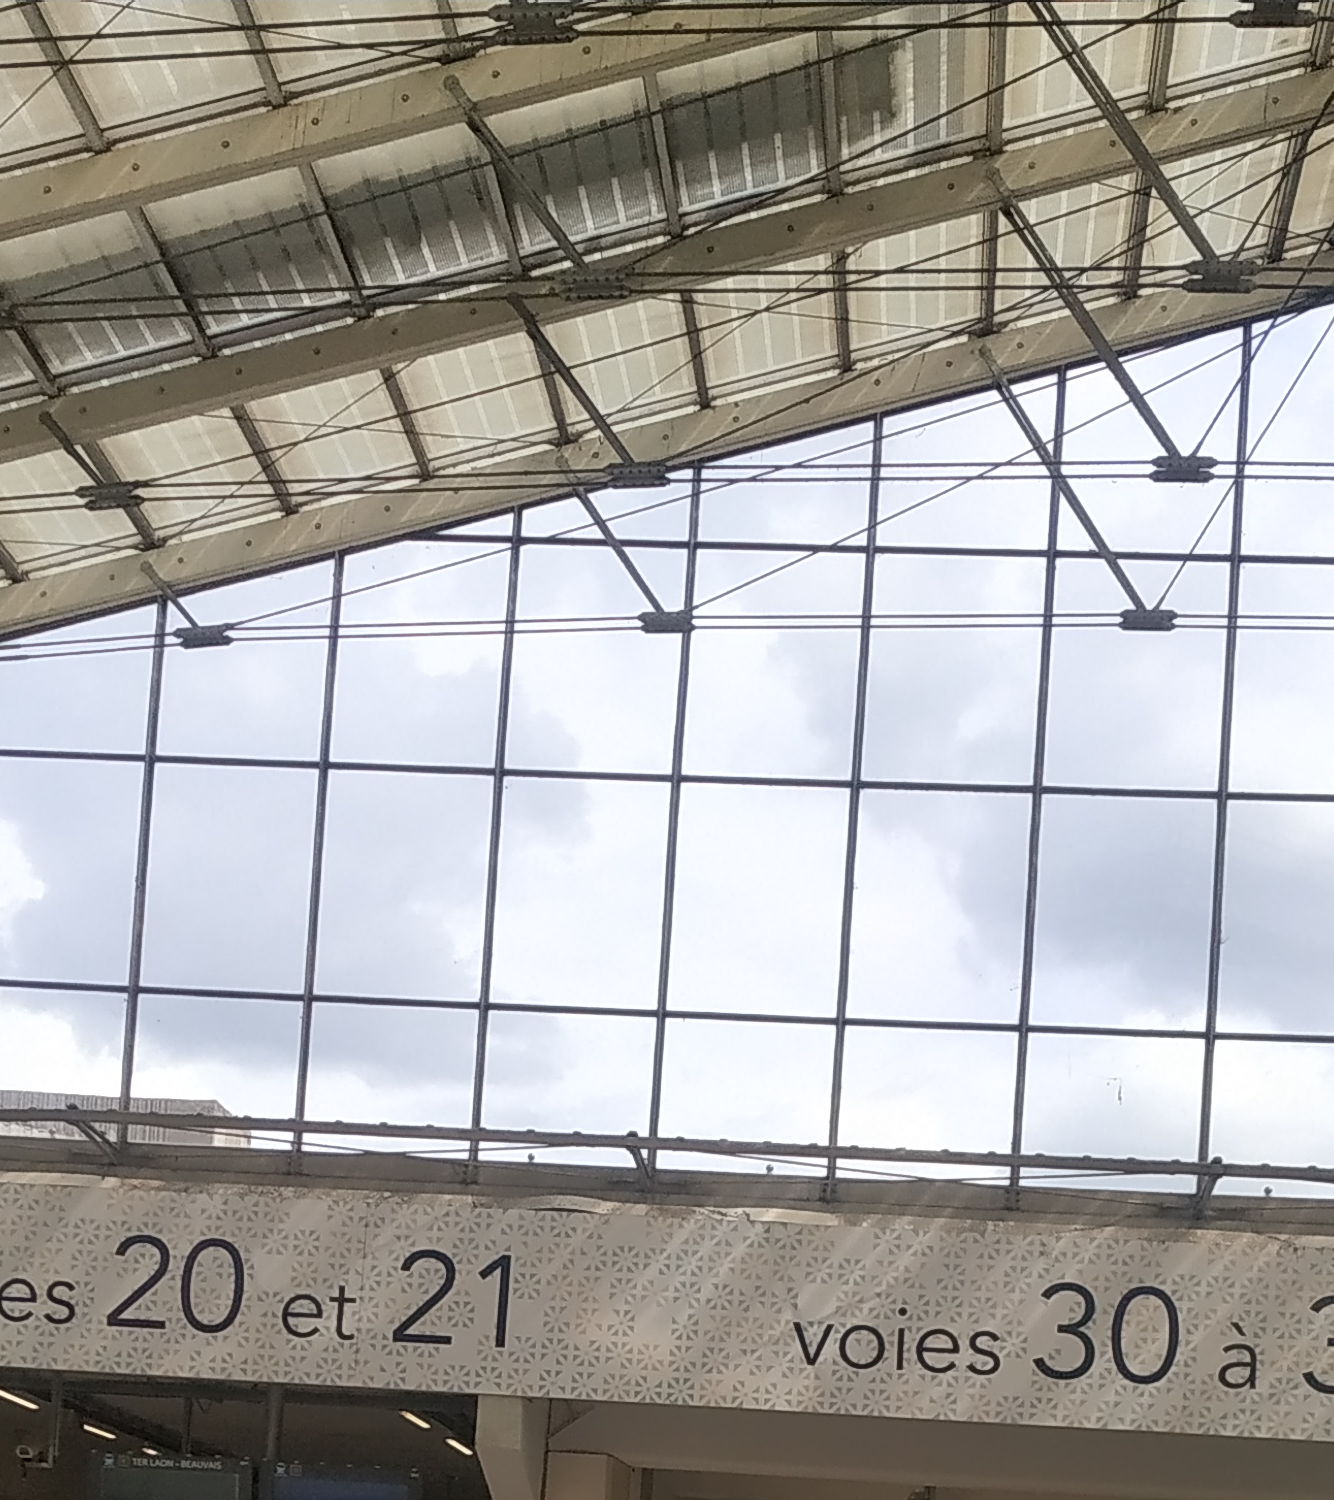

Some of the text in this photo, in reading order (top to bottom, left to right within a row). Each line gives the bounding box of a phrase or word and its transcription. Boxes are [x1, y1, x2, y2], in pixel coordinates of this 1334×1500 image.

[106, 1233, 245, 1334] 20
[282, 1283, 357, 1341] et
[392, 1248, 513, 1349] 21
[792, 1306, 1002, 1376] voies
[1032, 1281, 1180, 1385] 30
[1217, 1321, 1259, 1390] à
[131, 1457, 149, 1467] TER
[180, 1459, 222, 1470] BEAUVAIS
